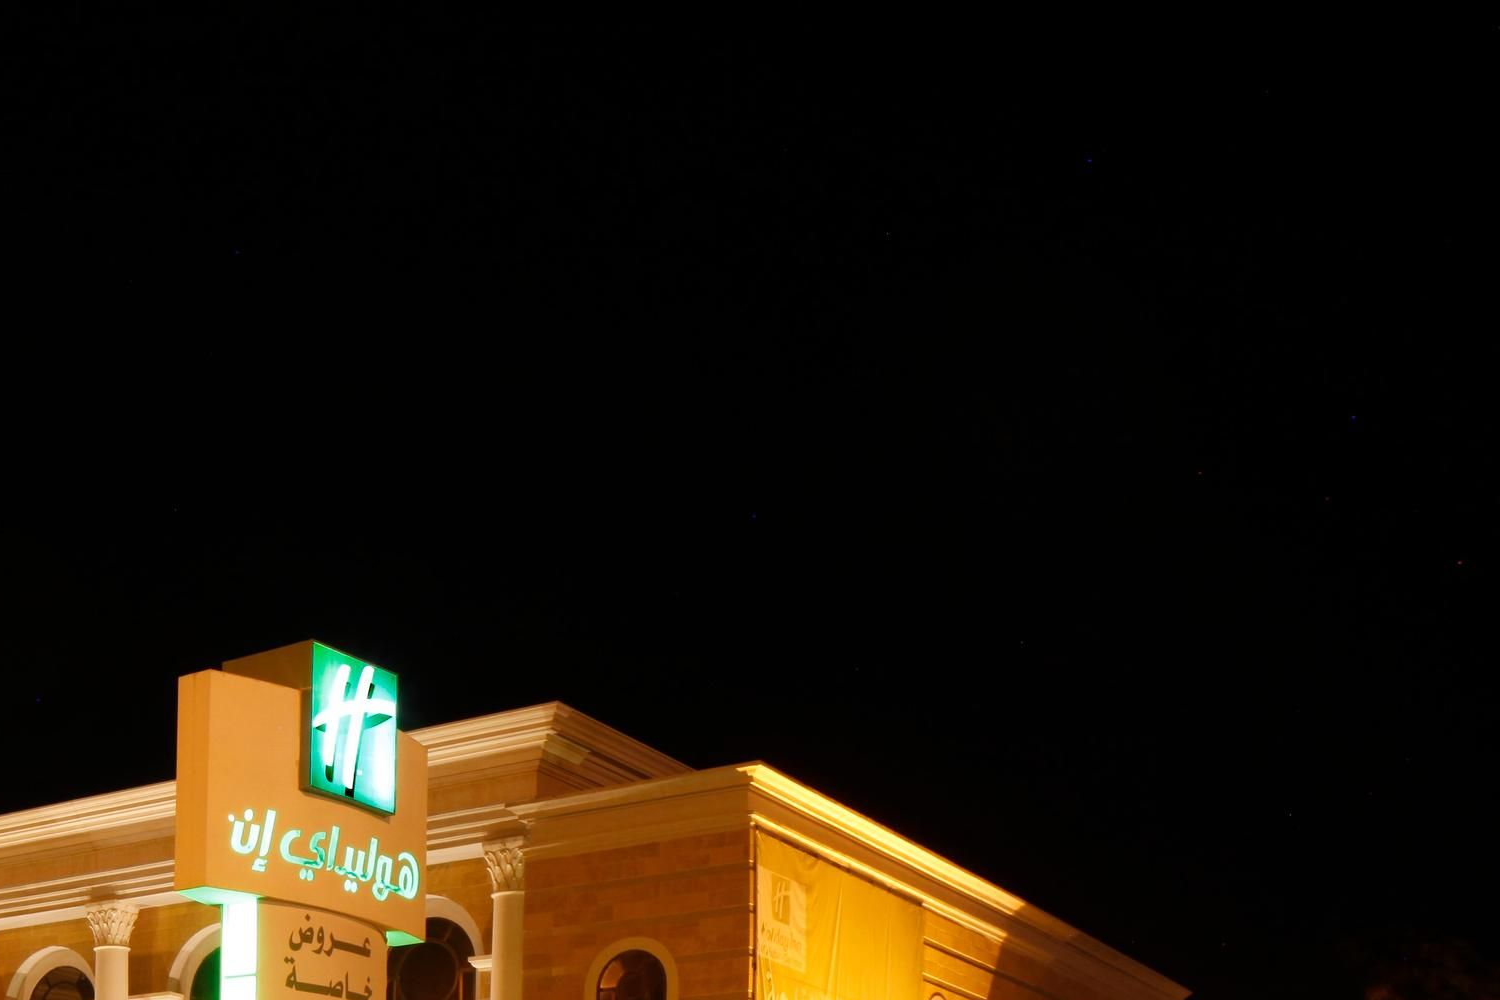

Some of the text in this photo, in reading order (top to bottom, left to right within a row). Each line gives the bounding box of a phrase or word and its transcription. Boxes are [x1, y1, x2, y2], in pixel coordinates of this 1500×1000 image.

[228, 808, 419, 901] هوليداي إن
[288, 913, 372, 958] عروض
